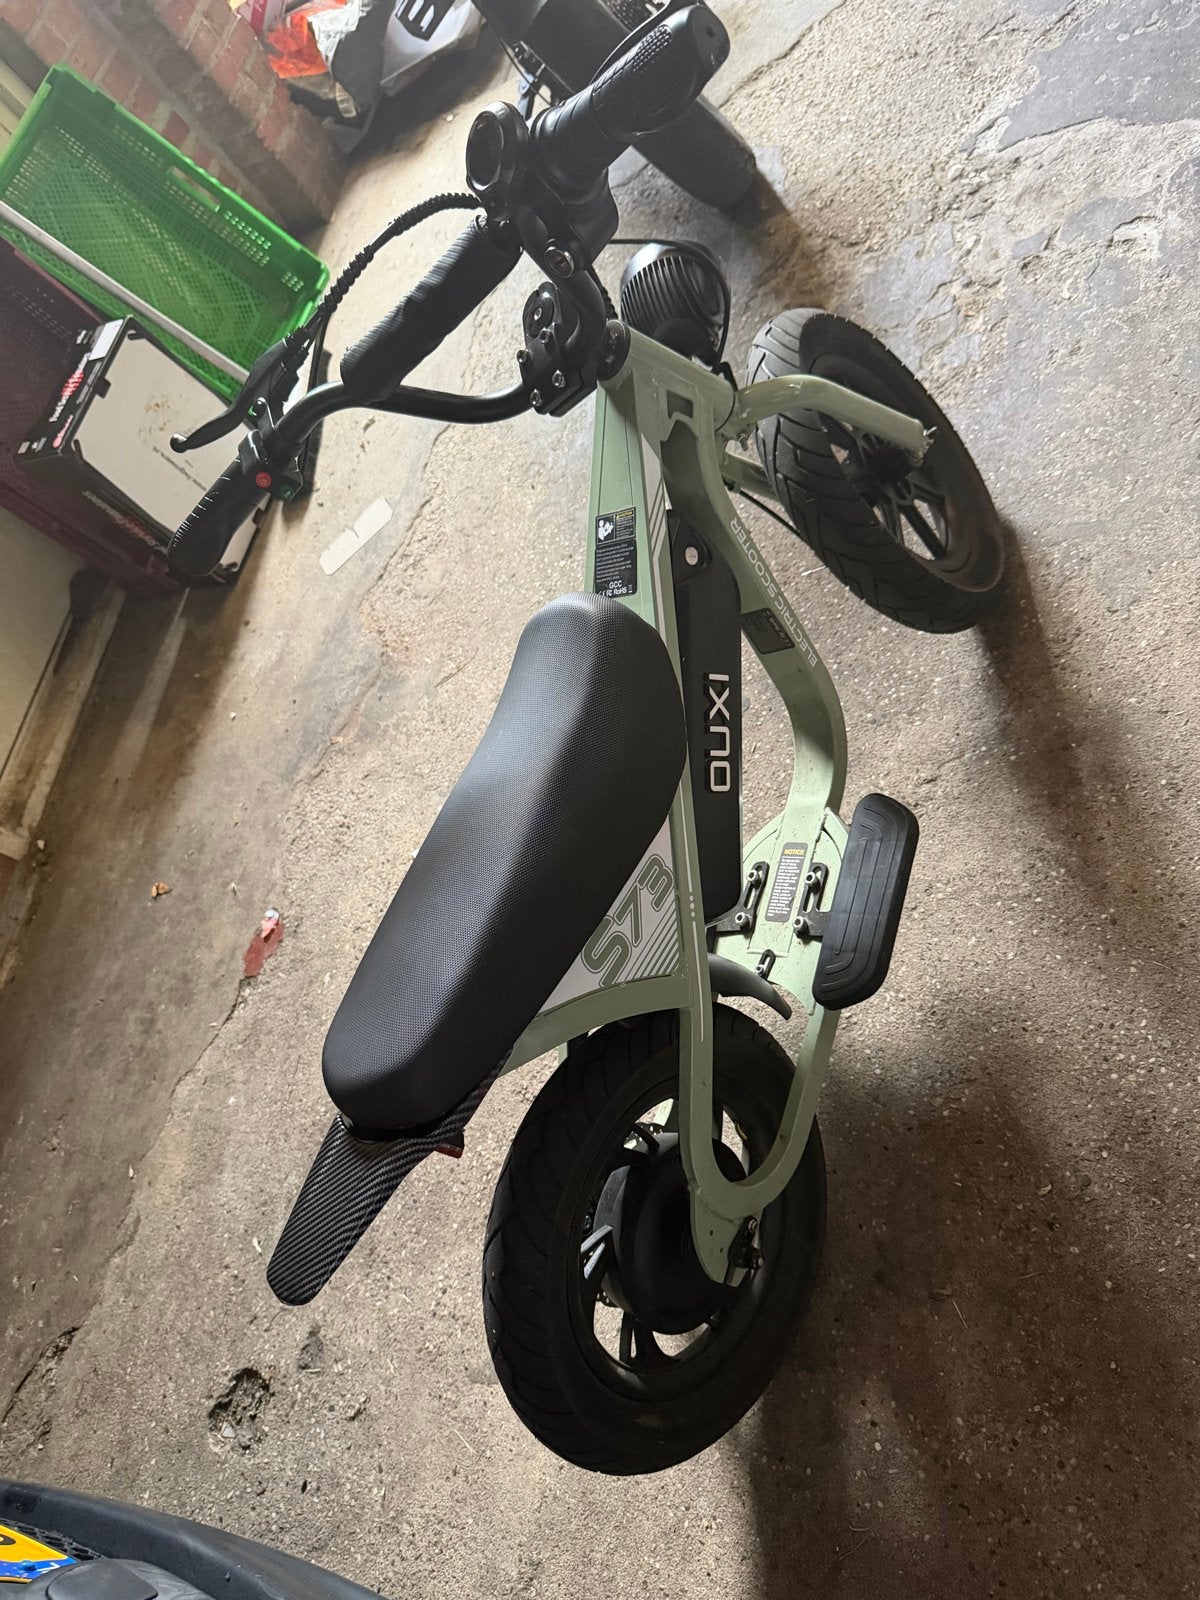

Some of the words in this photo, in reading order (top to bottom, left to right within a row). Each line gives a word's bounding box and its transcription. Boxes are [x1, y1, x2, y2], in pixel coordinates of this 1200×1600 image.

[609, 580, 622, 589] GCC
[613, 586, 627, 596] RoHS
[730, 517, 777, 598] SCOOTER
[774, 595, 818, 667] ELECTRIC
[708, 673, 731, 792] OUXI
[783, 848, 805, 856] NOTICE
[581, 853, 675, 988] S73
